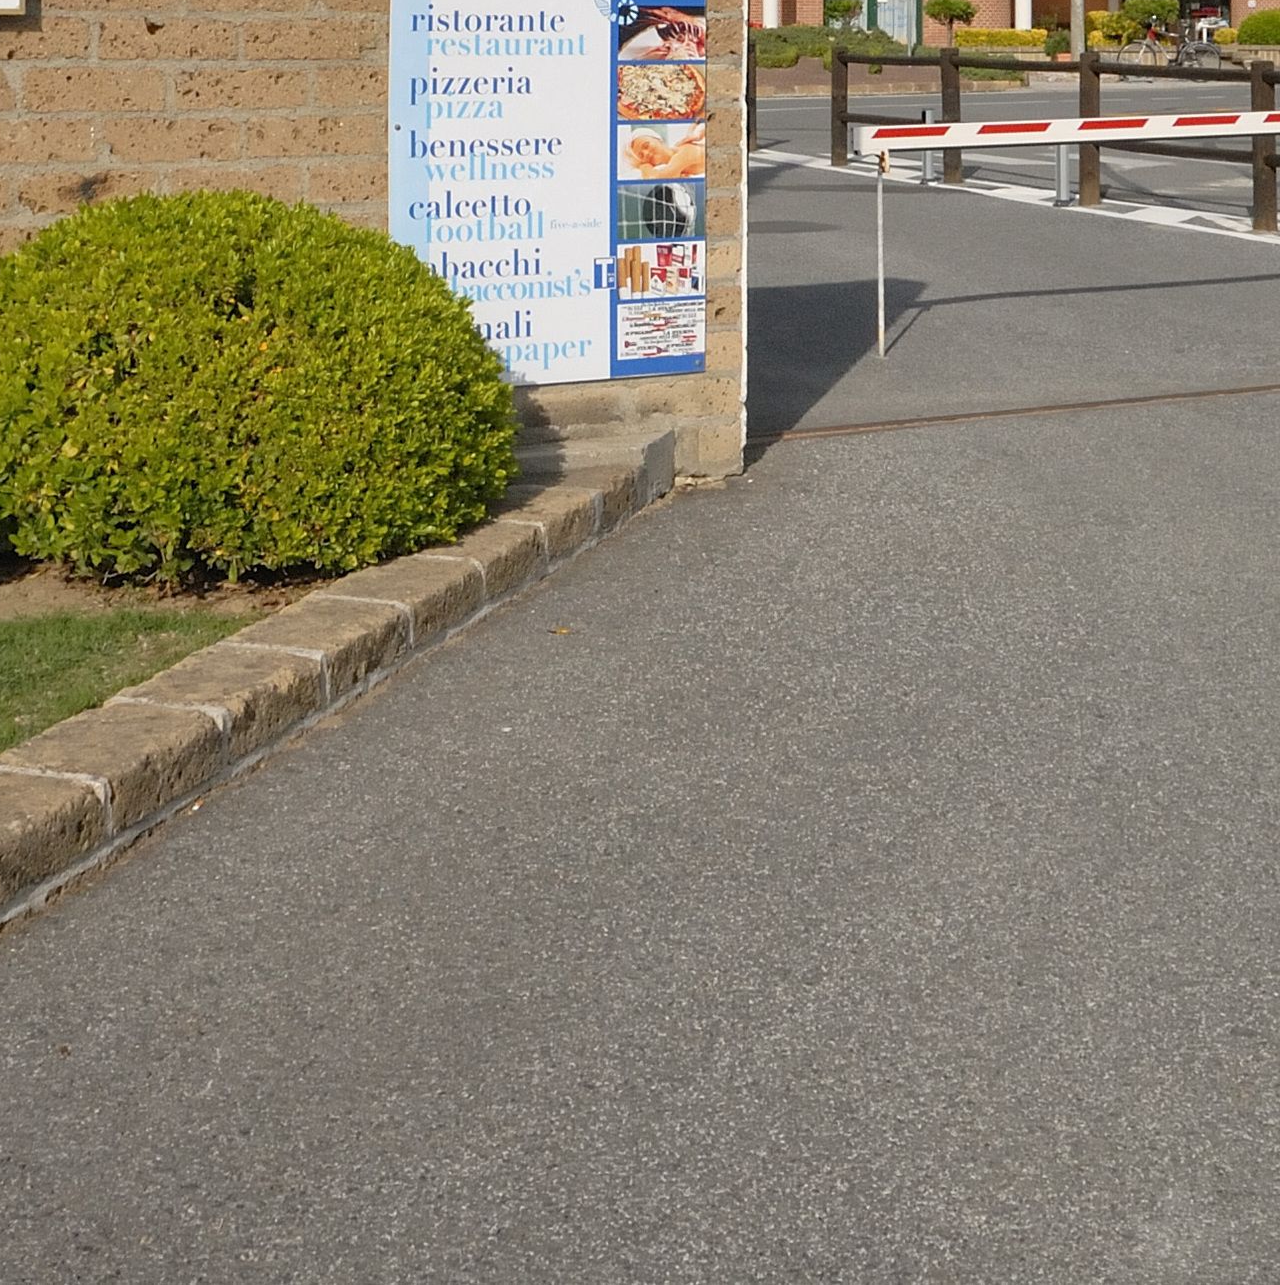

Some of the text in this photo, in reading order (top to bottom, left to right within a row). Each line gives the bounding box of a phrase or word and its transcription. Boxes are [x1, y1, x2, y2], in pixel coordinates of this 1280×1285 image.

[411, 4, 566, 33] ristorante
[426, 33, 588, 57] restaurant
[409, 66, 532, 106] pizzeria
[426, 91, 504, 130] pizza
[409, 129, 563, 159] benessere
[424, 152, 556, 182] wellness
[408, 190, 532, 221] calcetto
[426, 210, 545, 244] football
